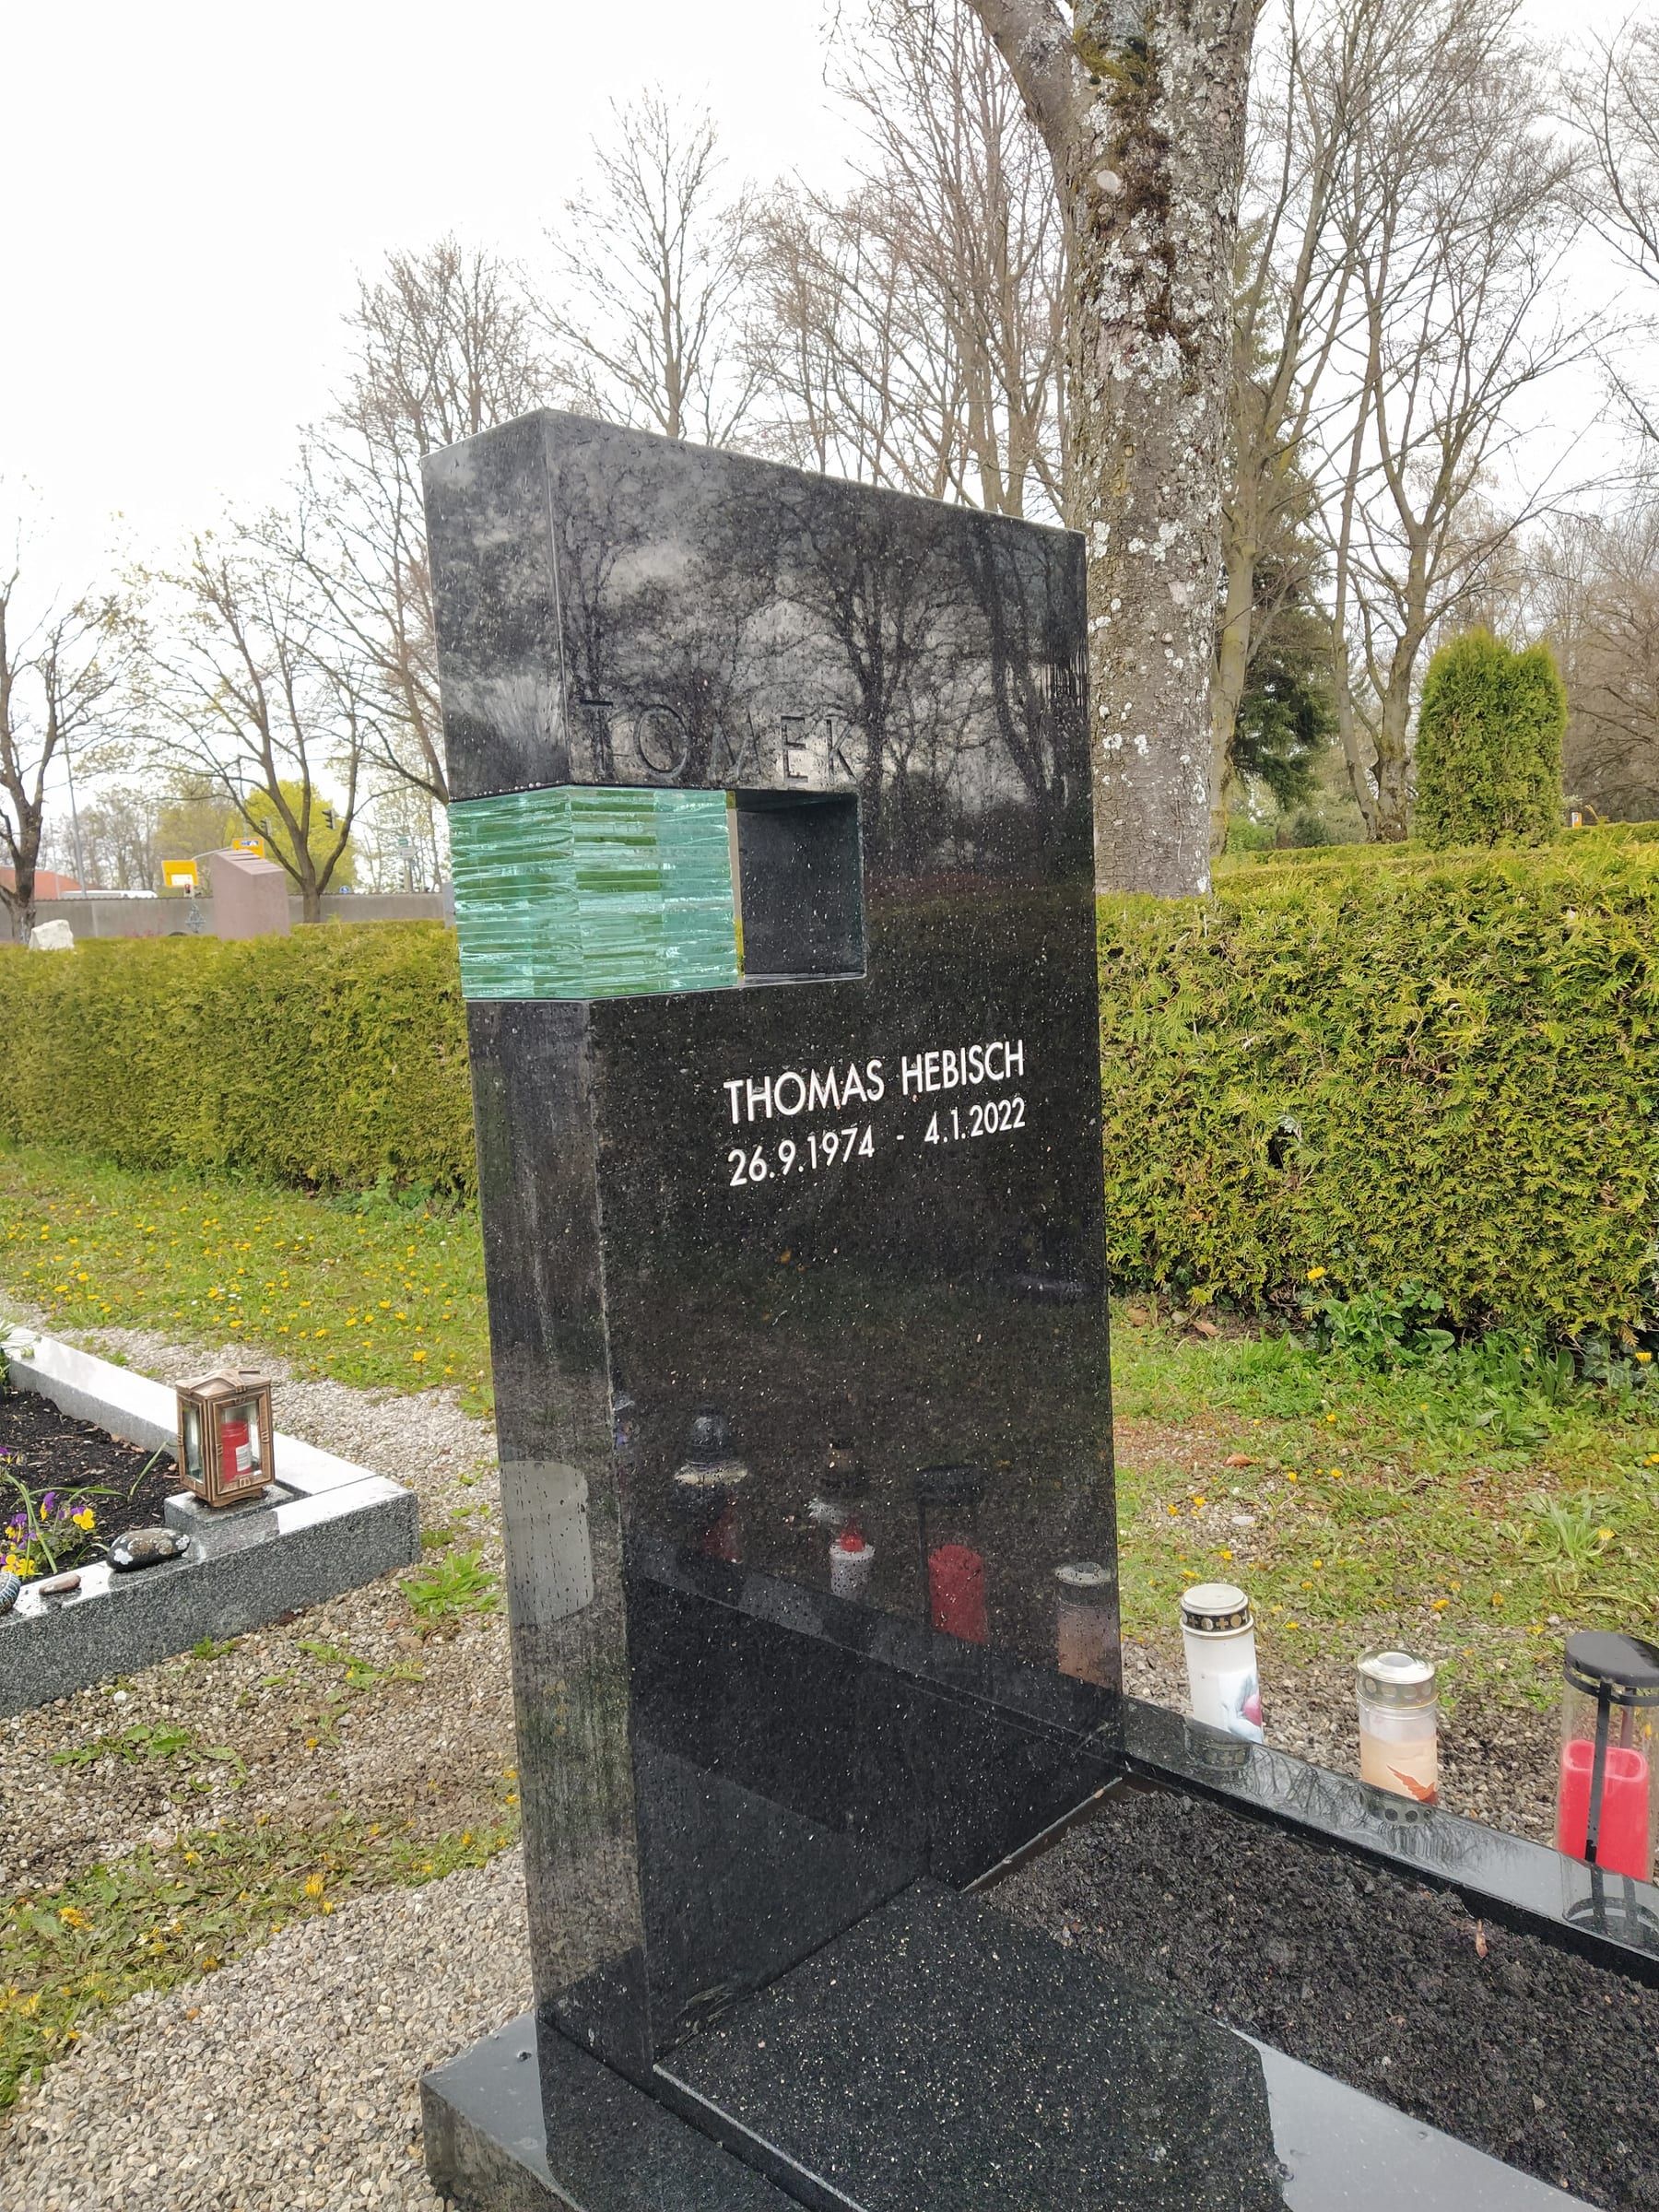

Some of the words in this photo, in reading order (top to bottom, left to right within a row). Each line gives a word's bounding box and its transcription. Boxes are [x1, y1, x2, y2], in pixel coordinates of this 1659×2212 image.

[579, 698, 859, 784] TOMEK
[723, 1058, 885, 1124] THOMAS
[901, 1039, 1025, 1096] HEBISCH
[727, 1124, 876, 1187] 26.9.1974
[924, 1097, 1027, 1145] 4.1.2022
